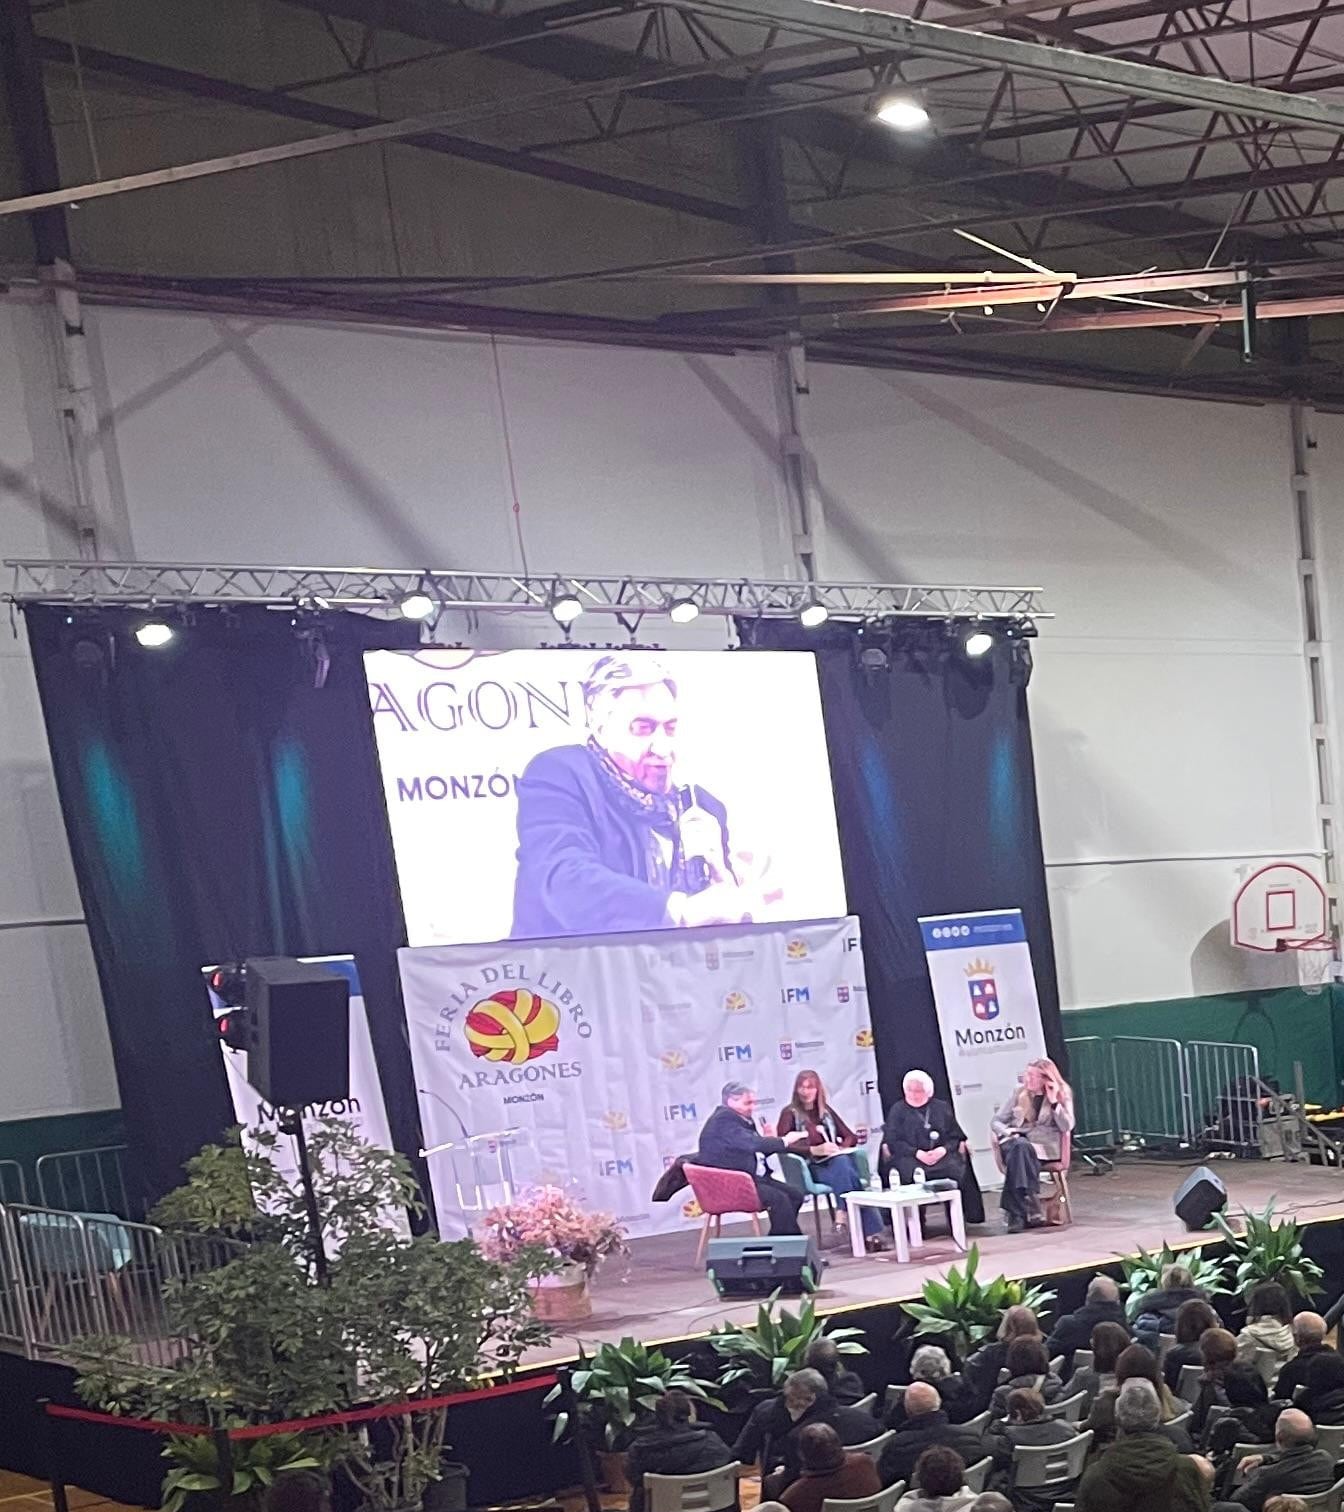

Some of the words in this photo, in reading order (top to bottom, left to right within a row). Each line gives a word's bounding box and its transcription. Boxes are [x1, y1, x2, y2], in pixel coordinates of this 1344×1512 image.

[369, 681, 592, 731] AGON
[781, 987, 810, 1003] IFM
[435, 981, 479, 1052] FERIA
[480, 963, 530, 984] DEL
[537, 972, 593, 1039] LIBRO
[955, 1023, 1025, 1047] Monzón
[718, 1045, 752, 1061] IFM
[459, 1061, 582, 1090] ARAGONES
[664, 1103, 697, 1121] IFM
[600, 1158, 634, 1176] IFM
